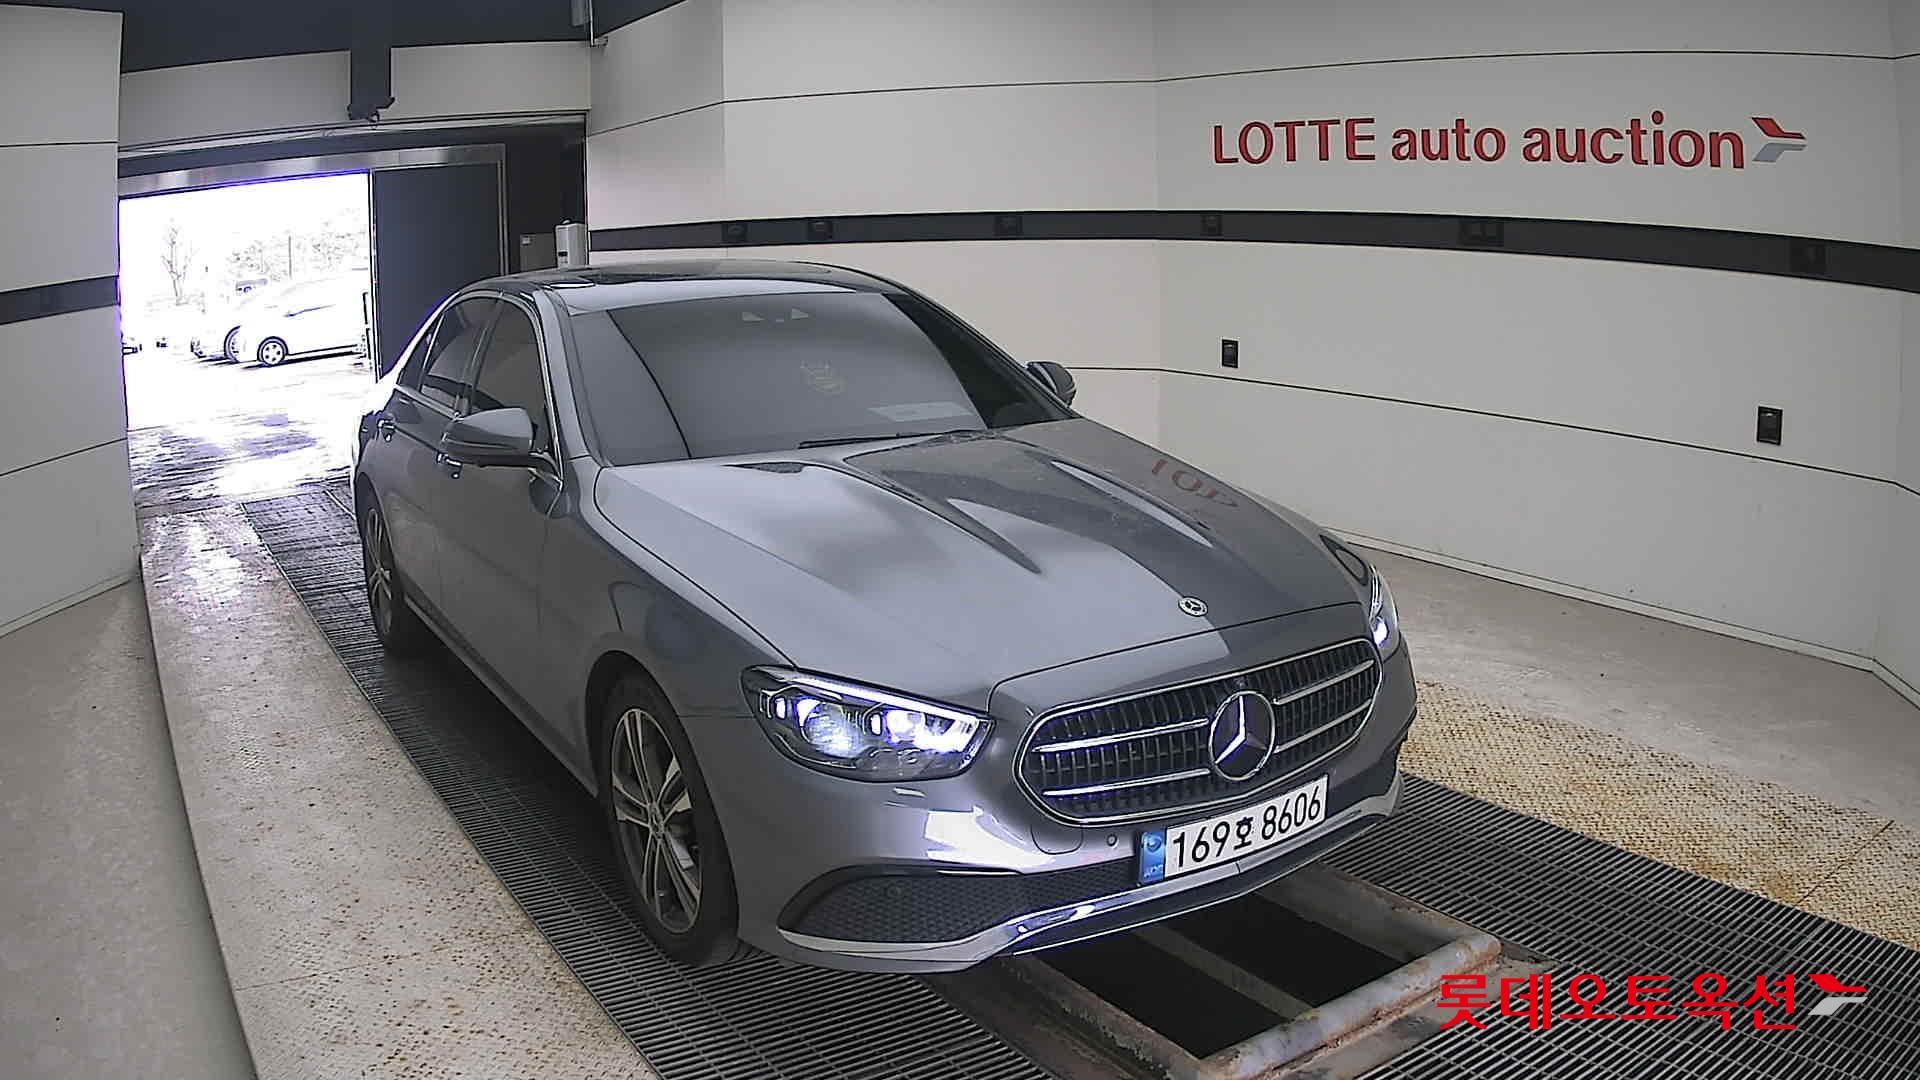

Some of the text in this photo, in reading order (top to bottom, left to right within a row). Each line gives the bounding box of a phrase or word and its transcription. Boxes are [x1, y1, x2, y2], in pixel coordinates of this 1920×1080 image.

[1213, 110, 1745, 170] LOTTE auto auction
[1172, 785, 1321, 868] 169호 8606
